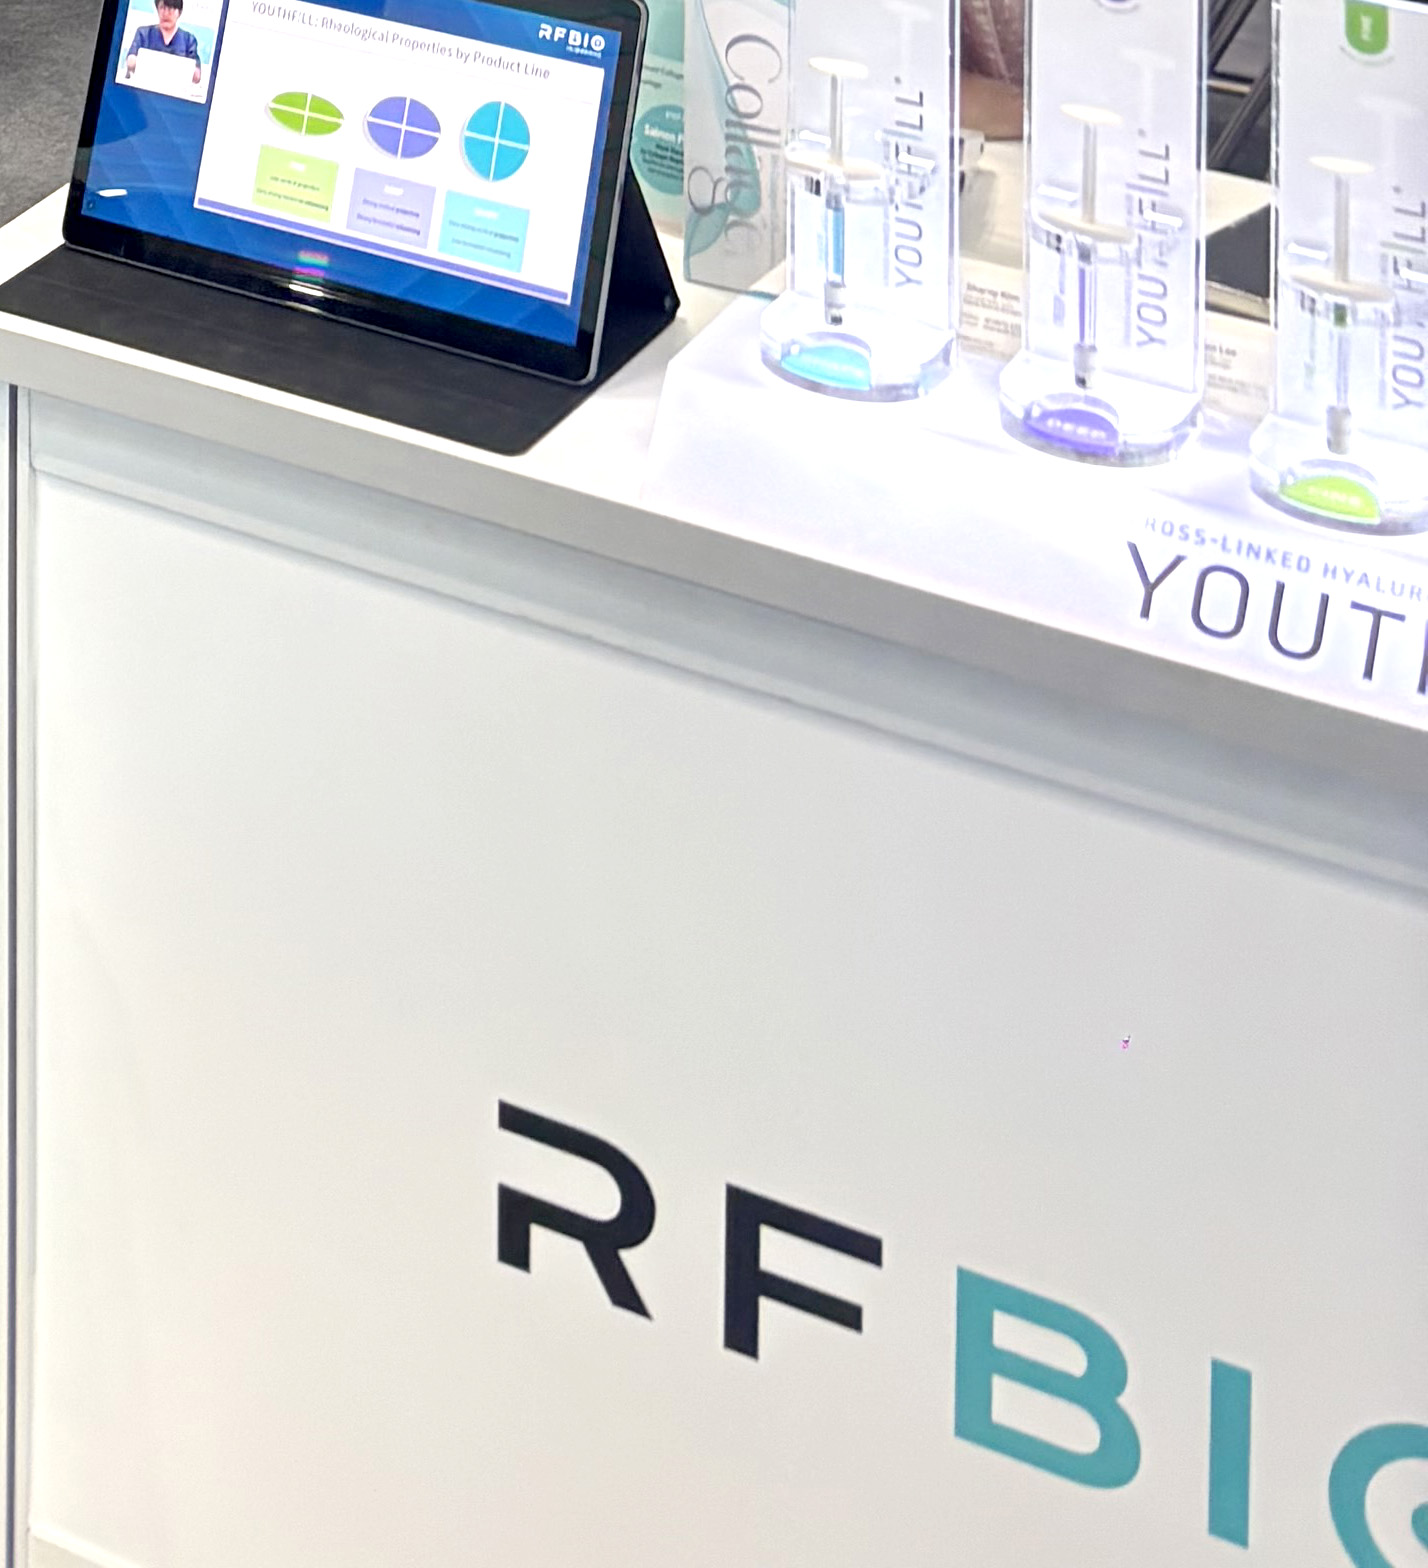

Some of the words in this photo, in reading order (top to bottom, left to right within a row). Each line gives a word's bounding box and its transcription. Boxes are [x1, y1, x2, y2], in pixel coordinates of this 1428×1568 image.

[392, 32, 453, 57] Properties
[455, 51, 470, 64] by
[473, 51, 522, 74] Product
[523, 63, 551, 80] Line
[1145, 515, 1312, 573] ROSS-LINKED
[1322, 561, 1428, 602] HYALUR
[1127, 540, 1428, 696] YOUT
